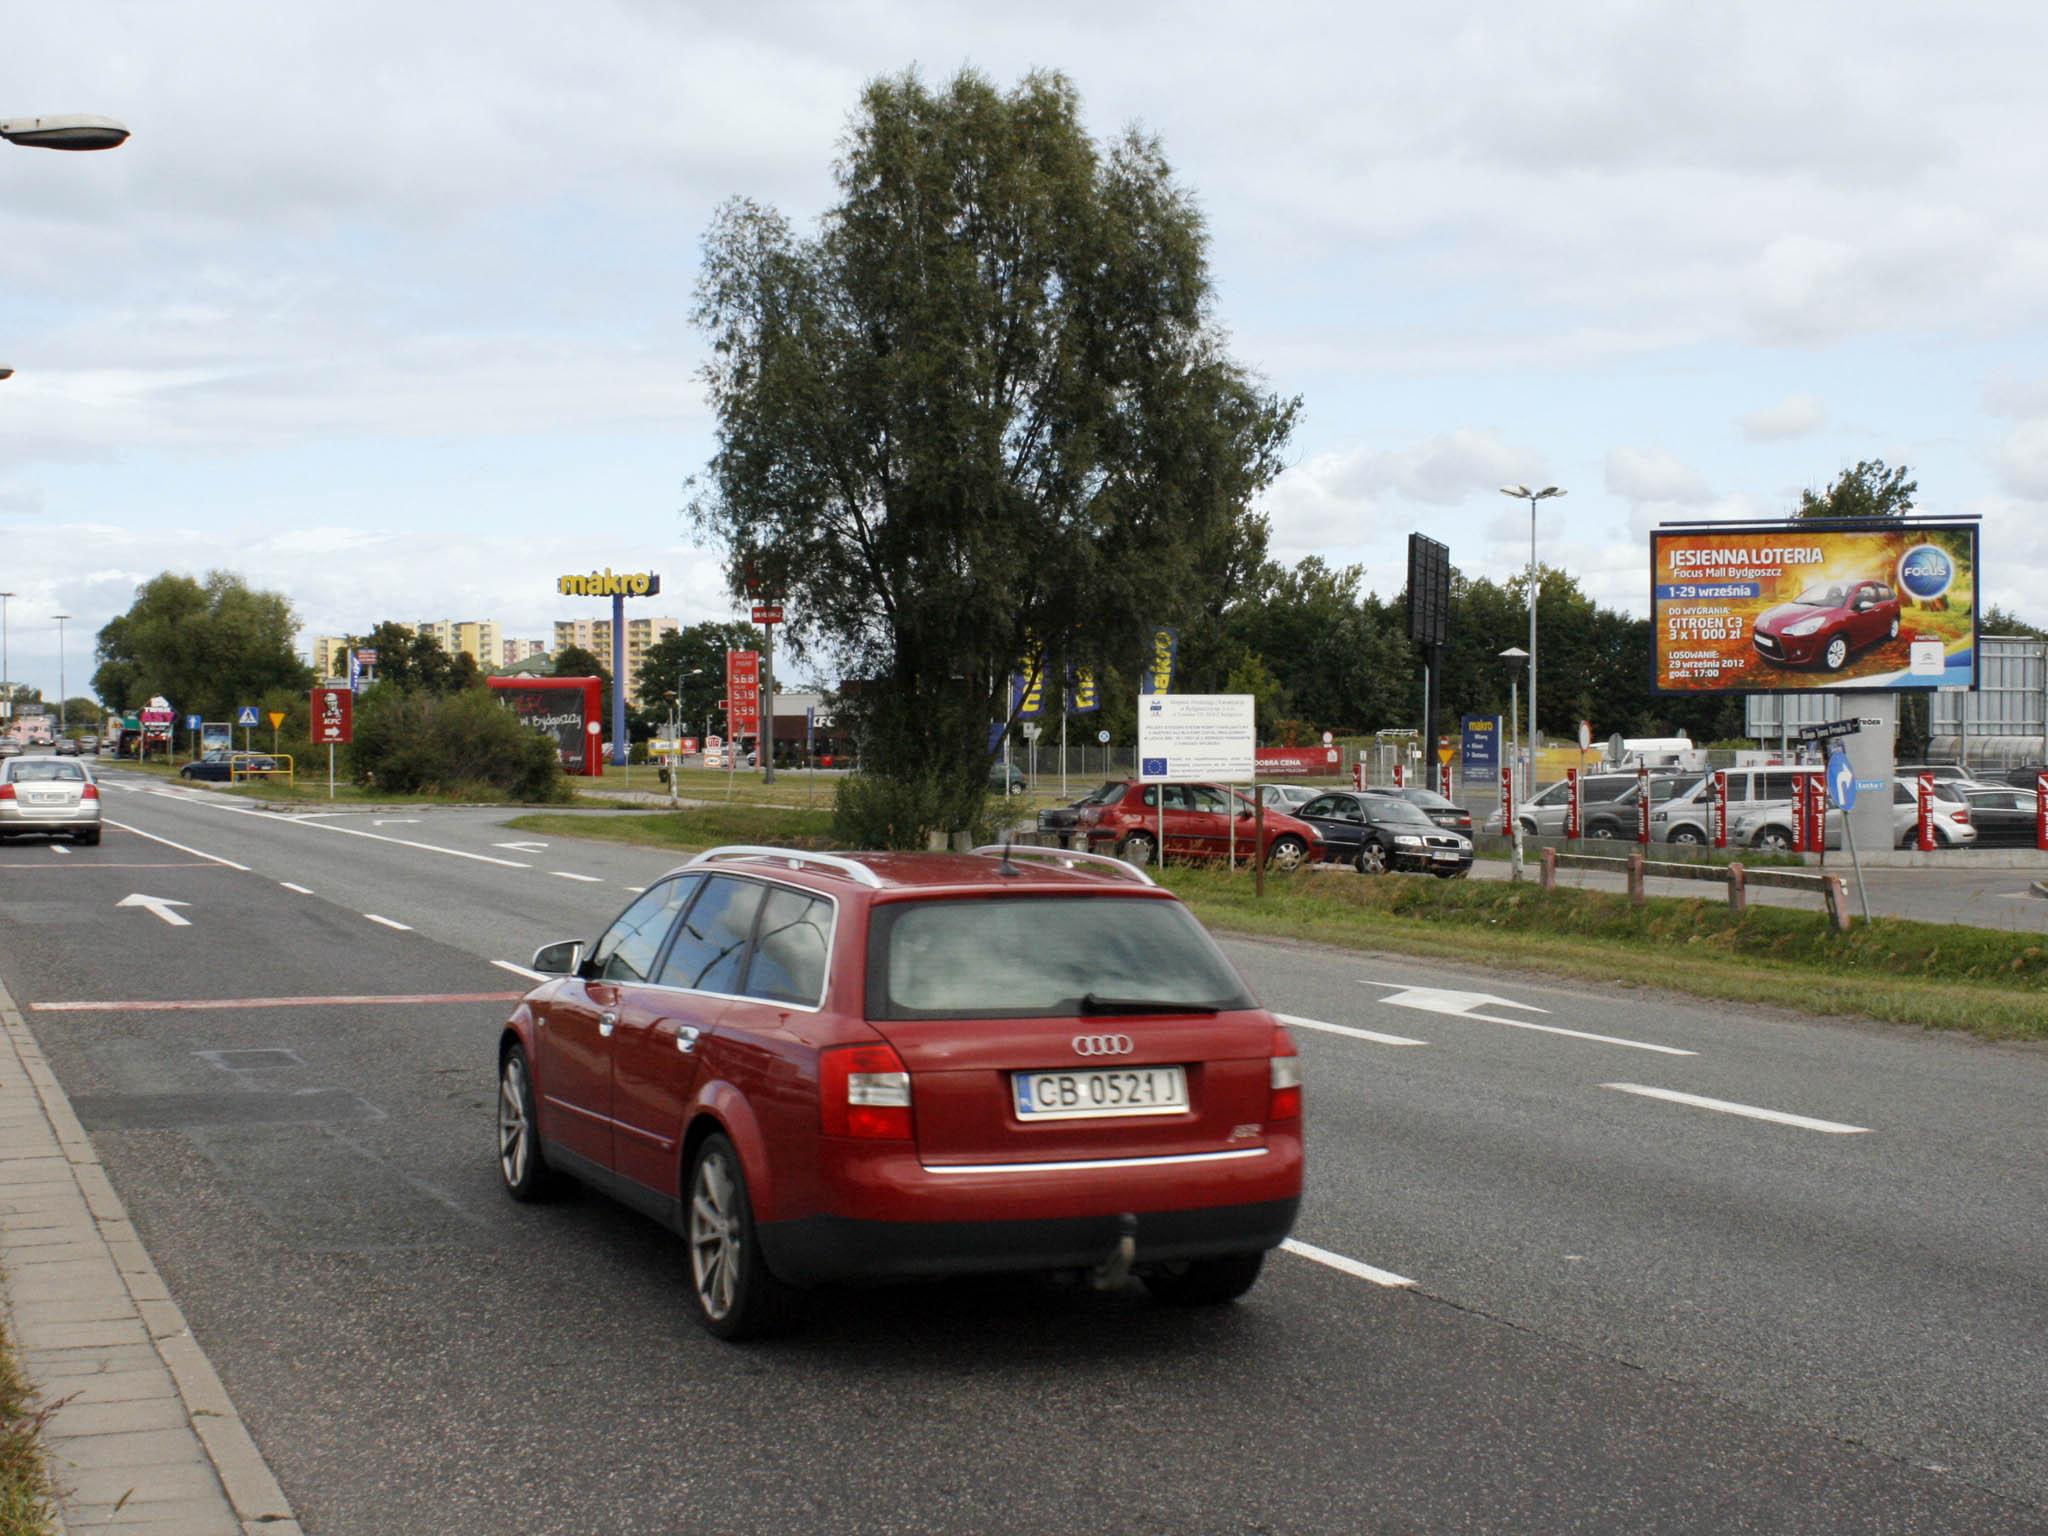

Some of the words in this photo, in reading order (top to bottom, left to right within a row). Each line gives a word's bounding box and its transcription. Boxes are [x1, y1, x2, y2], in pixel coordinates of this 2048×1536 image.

[1669, 550, 1749, 569] JESIENNA
[1751, 547, 1824, 564] LOTERIA
[1673, 568, 1703, 578] Focus
[1705, 567, 1726, 577] Mall
[1728, 567, 1782, 578] Bydgoszcz
[1904, 567, 1946, 576] FOCUS
[560, 567, 650, 595] makro
[1669, 586, 1696, 597] 1-29
[1698, 584, 1751, 597] września
[1668, 607, 1681, 615] DO
[1682, 607, 1731, 615] WYGRANIA:
[1669, 617, 1724, 629] CITROEN
[1727, 616, 1743, 628] C3
[1669, 629, 1677, 640] 3
[1680, 631, 1688, 640] x
[1729, 628, 1741, 639] zł
[1669, 651, 1719, 659] LOSOWANIE:
[1669, 660, 1681, 668] 29
[1682, 660, 1719, 668] września
[1721, 659, 1744, 668] 2012
[1669, 670, 1692, 679] godz.
[1694, 669, 1719, 677] 17:00
[814, 716, 834, 727] KFC
[1792, 813, 1800, 844] partner
[1037, 1076, 1078, 1107] CB
